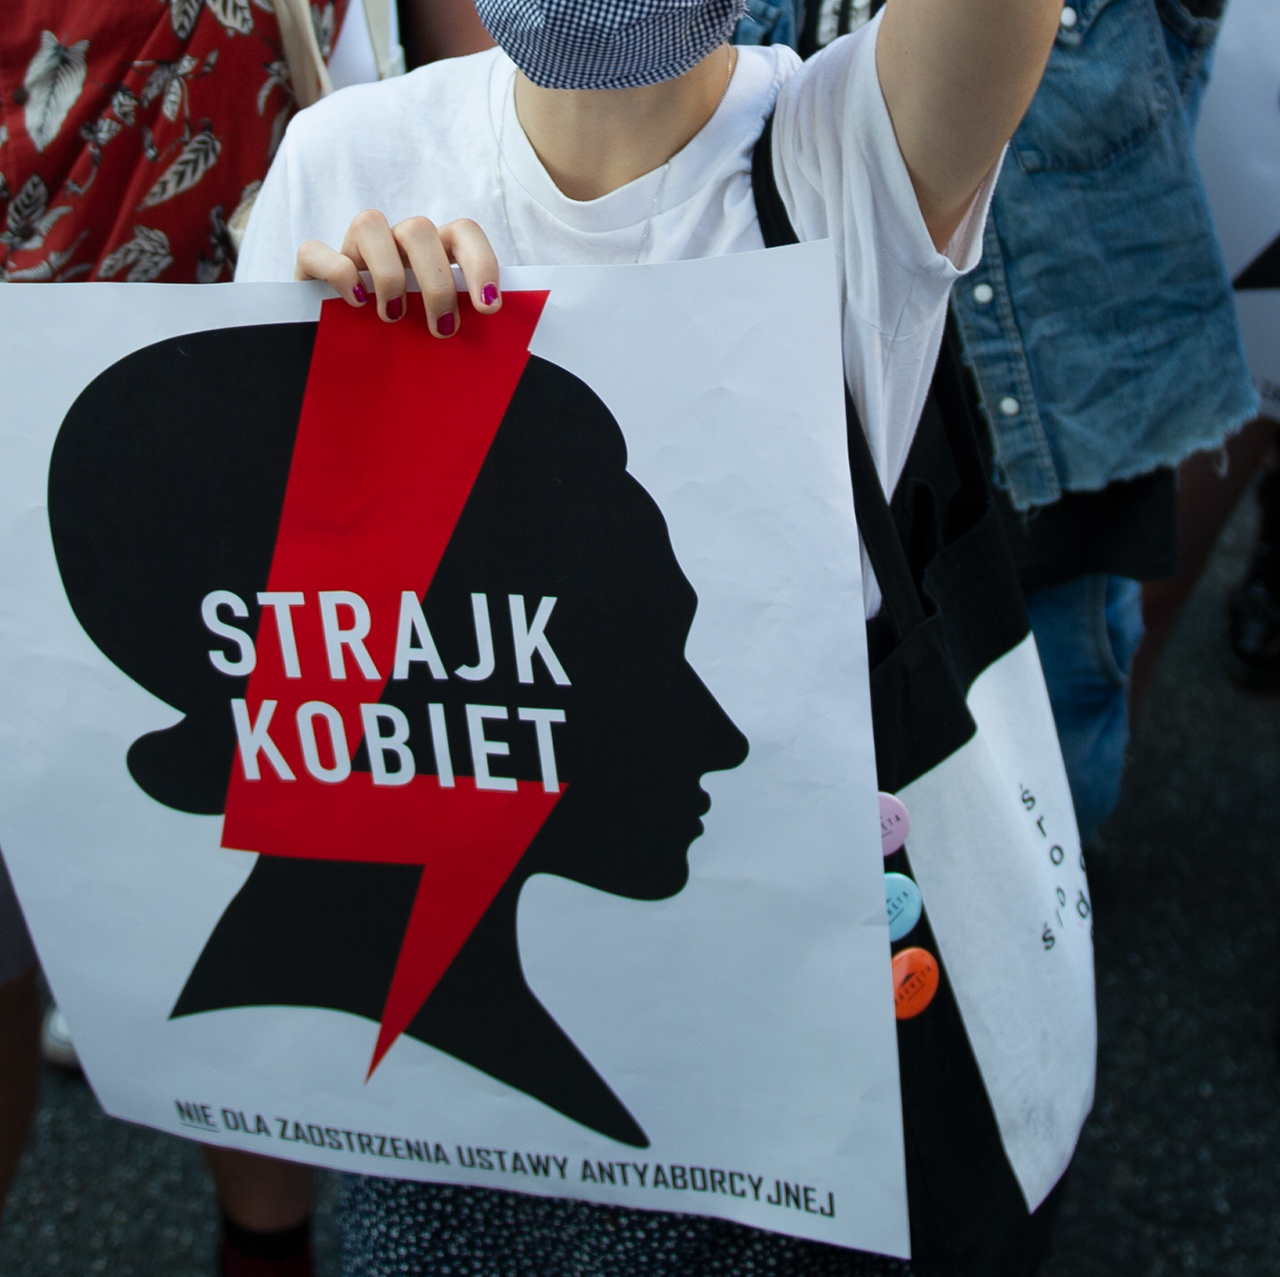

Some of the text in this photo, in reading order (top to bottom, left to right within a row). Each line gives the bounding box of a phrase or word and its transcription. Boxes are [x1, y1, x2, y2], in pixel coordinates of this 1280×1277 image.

[201, 589, 572, 687] STRAJK
[230, 698, 567, 795] KOBIET
[175, 1100, 837, 1219] NIE DLA ZAOSTRZENIA USTAWY ANTYABORCYJNEJ
